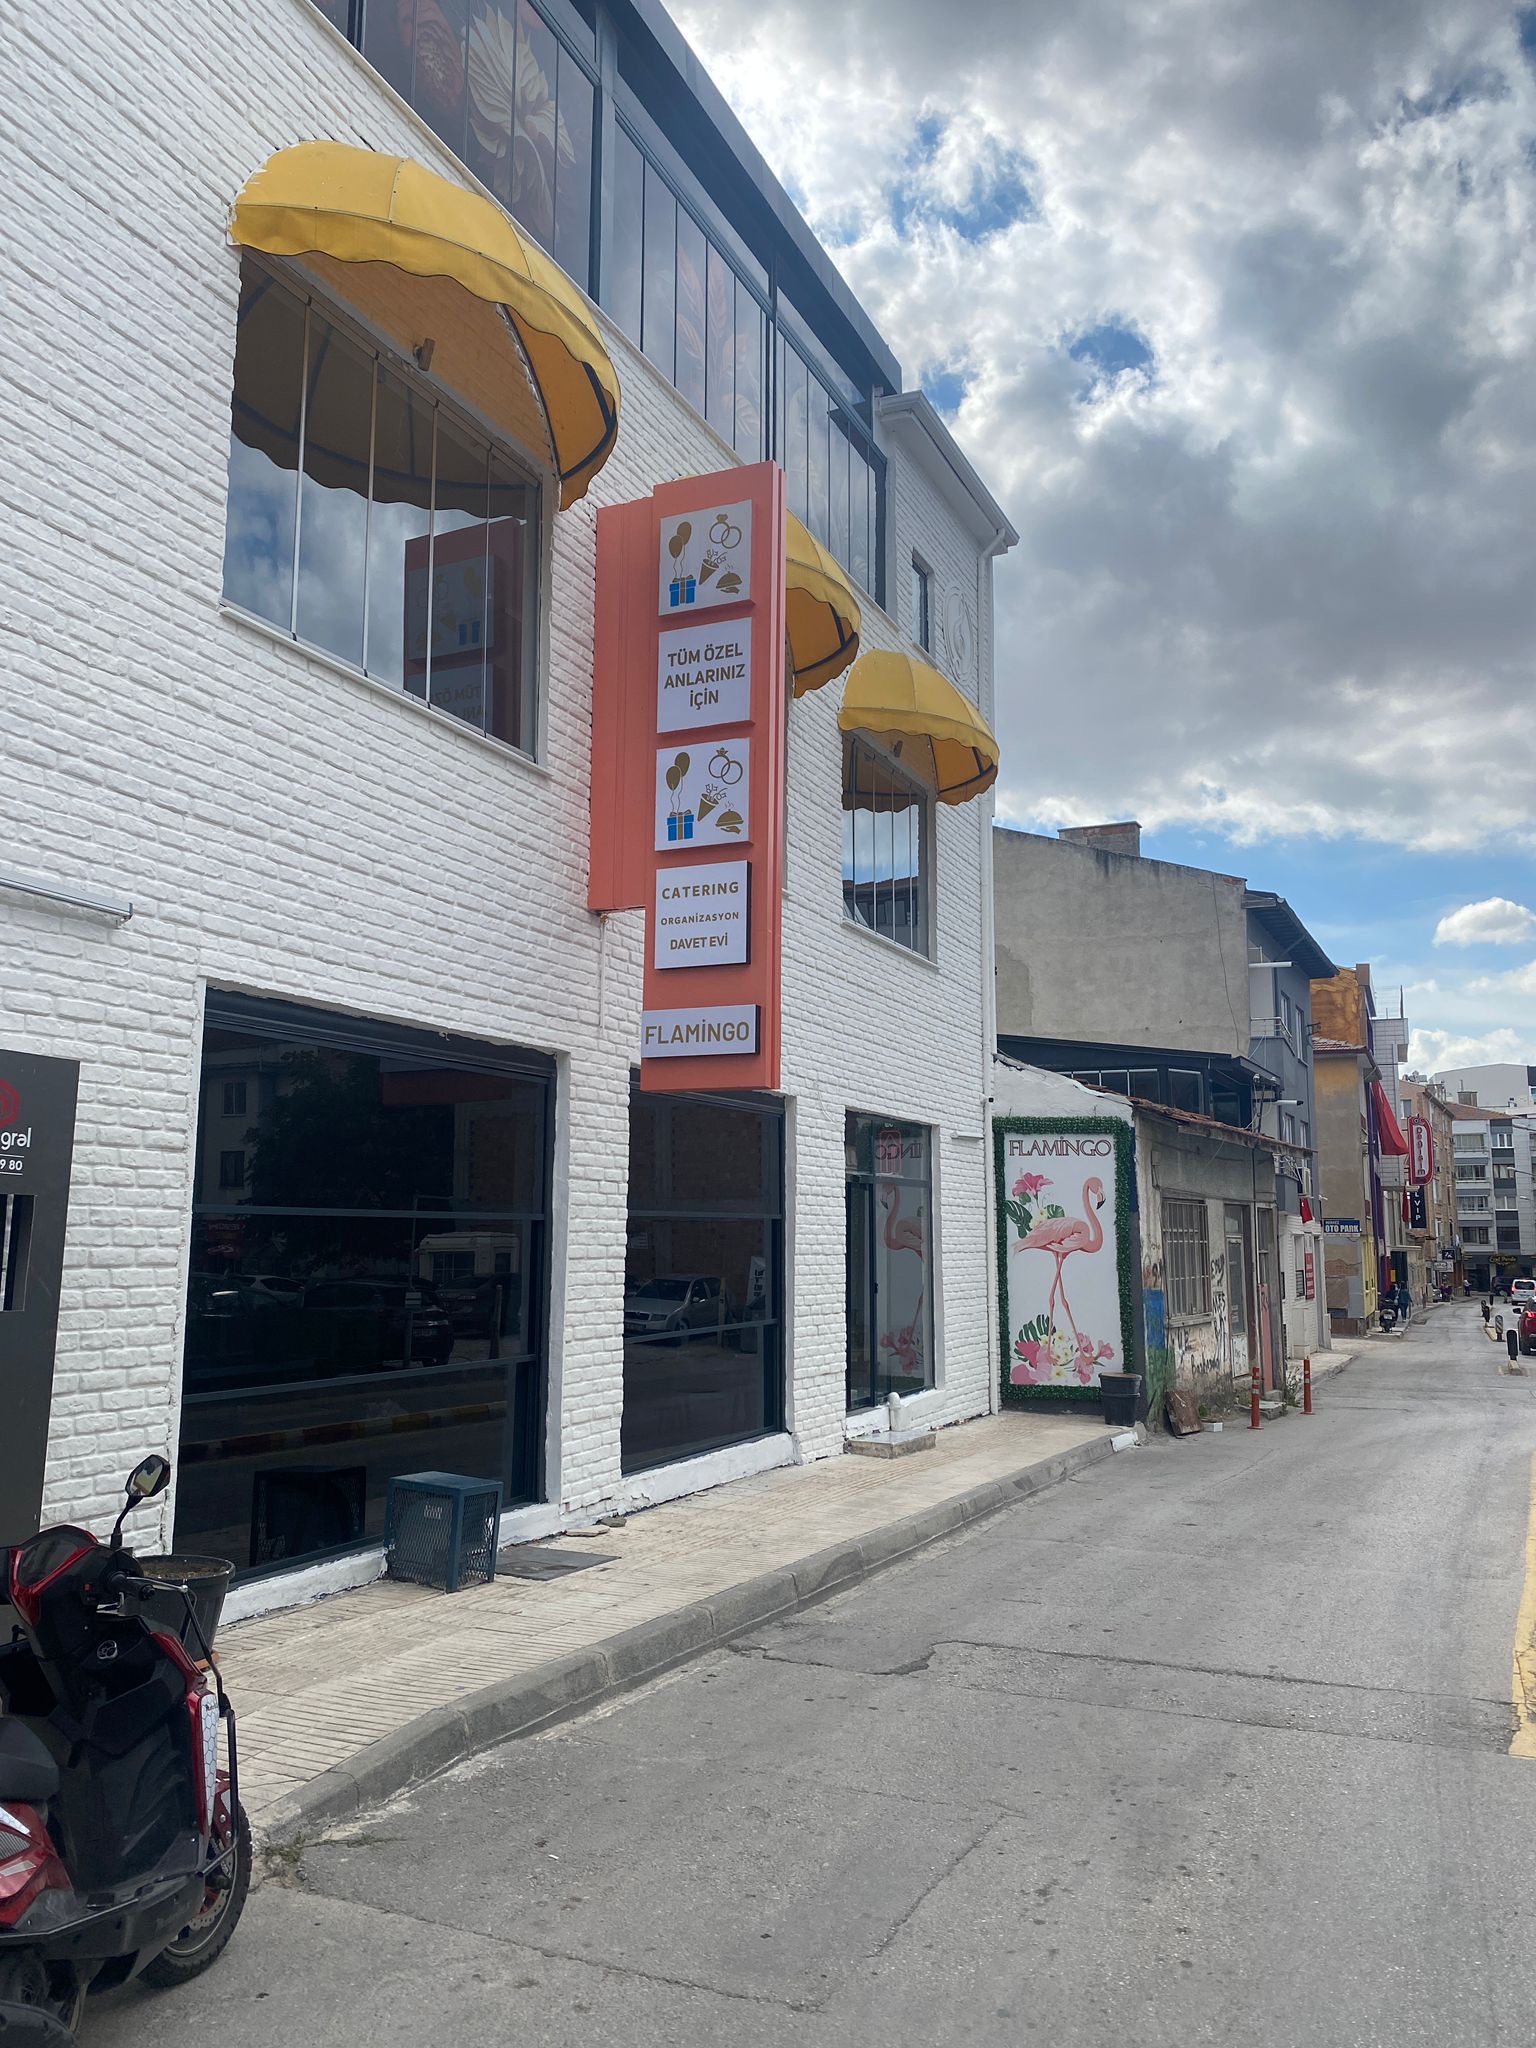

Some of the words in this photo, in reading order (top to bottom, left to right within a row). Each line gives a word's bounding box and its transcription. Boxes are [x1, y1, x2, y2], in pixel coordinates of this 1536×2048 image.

[667, 648, 701, 667] TÜM
[704, 643, 743, 662] ÖZEL
[664, 664, 746, 689] ANLARINIZ
[690, 688, 719, 711] İÇİN
[662, 881, 739, 900] CATERING
[661, 912, 739, 926] ORGANİZASYON
[670, 937, 707, 950] DAVET
[709, 932, 728, 947] EVİ
[645, 1019, 750, 1045] FLAMİNGO
[1009, 1135, 1112, 1157] FLAMİNGO
[8, 1160, 23, 1171] 80
[1325, 1225, 1339, 1233] OTO
[1340, 1225, 1359, 1233] PARK
